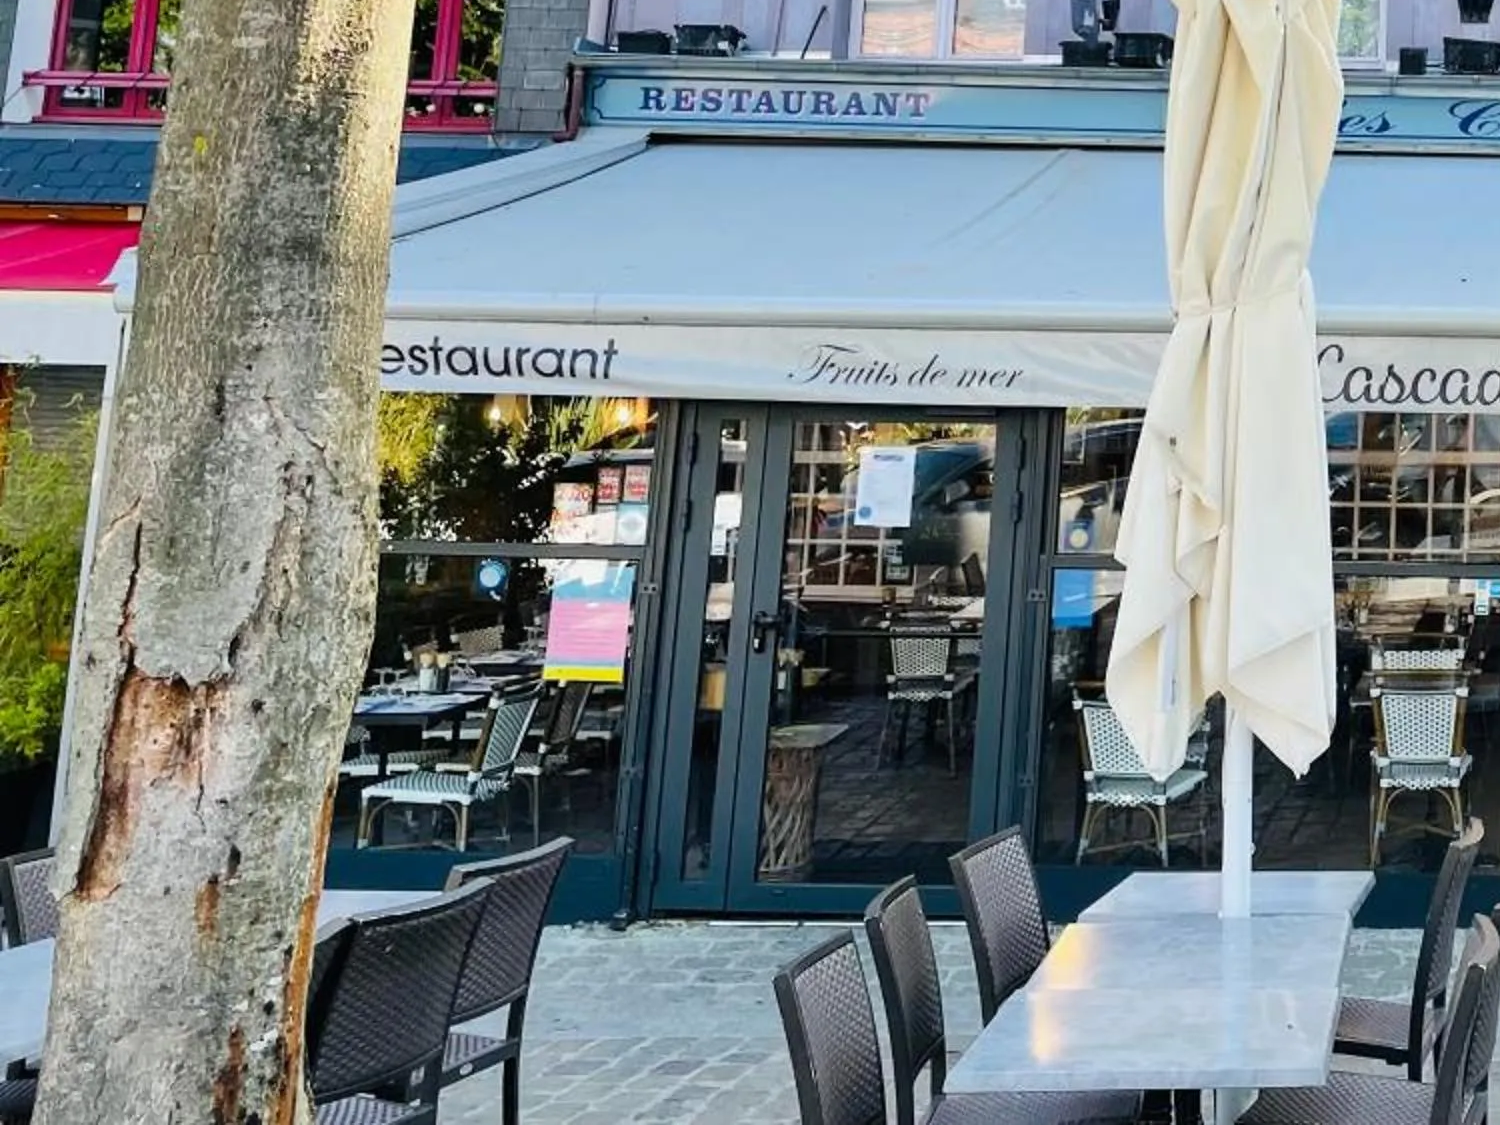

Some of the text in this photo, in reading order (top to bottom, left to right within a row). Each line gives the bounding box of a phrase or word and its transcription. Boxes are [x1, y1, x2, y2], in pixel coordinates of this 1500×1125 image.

[639, 86, 930, 118] RESTAURANT
[1338, 99, 1397, 133] es
[788, 343, 1024, 388] Fruits de mer
